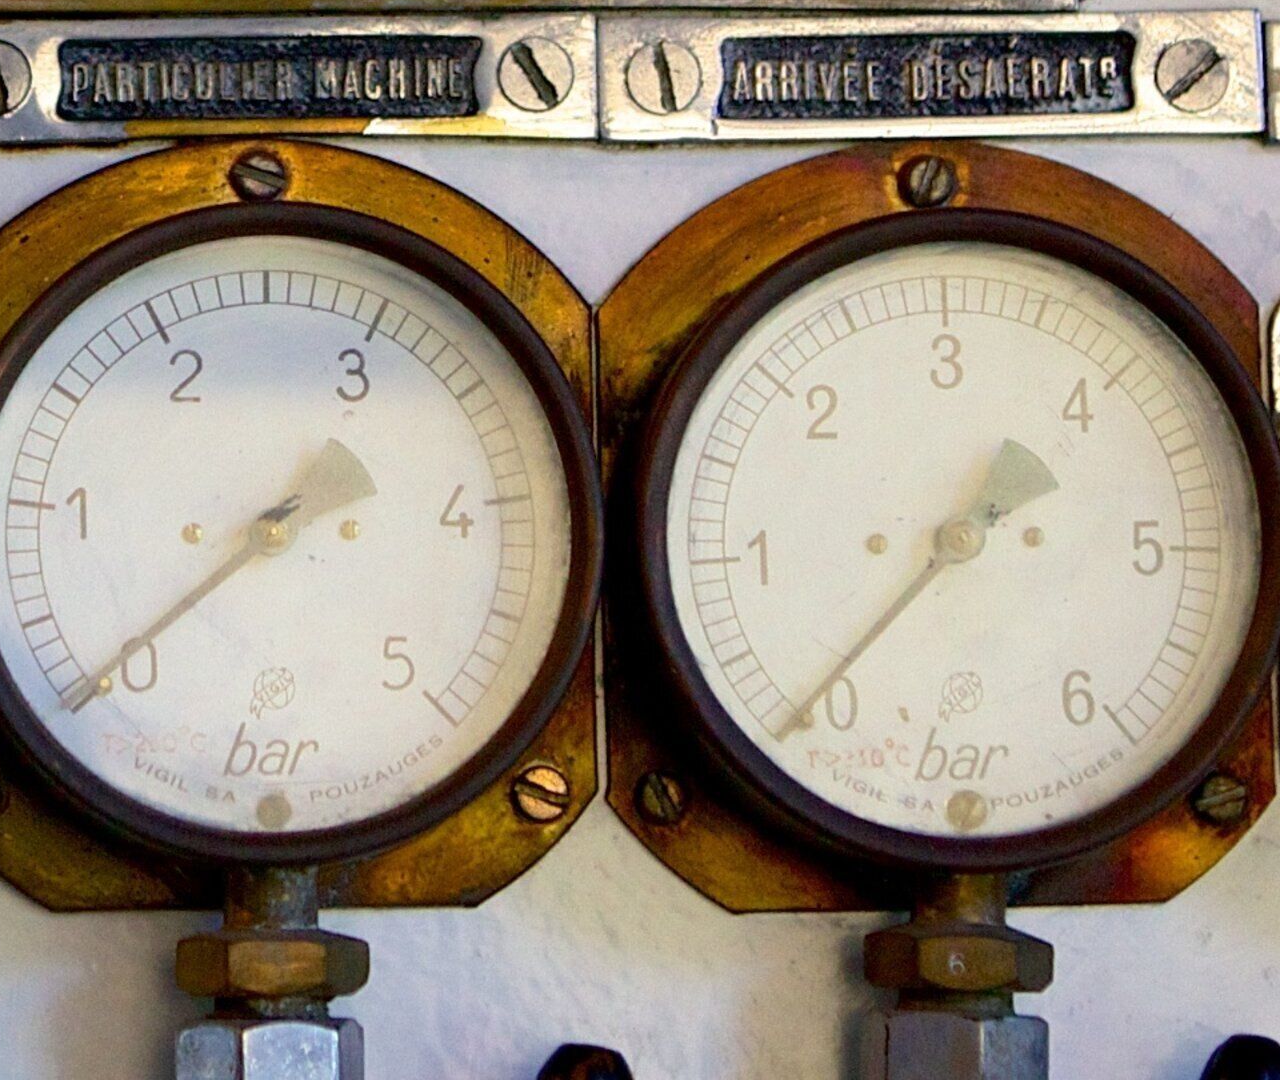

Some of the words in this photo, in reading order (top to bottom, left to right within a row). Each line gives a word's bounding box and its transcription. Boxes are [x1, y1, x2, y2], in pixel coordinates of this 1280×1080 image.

[315, 58, 464, 100] MACHINE
[169, 349, 203, 402] 2
[336, 348, 370, 402] 3
[930, 335, 963, 389] 3
[806, 385, 837, 439] 2
[1062, 378, 1094, 432] 4
[66, 486, 87, 539] 1
[440, 484, 473, 537] 4
[747, 530, 769, 585] 1
[1132, 521, 1164, 576] 5
[121, 637, 158, 692] 0
[383, 636, 415, 690] 5
[824, 676, 858, 731] 0
[1061, 670, 1095, 725] 6
[133, 755, 189, 791] VIGIL
[222, 721, 319, 778] bar
[309, 732, 444, 803] POUZAUGES
[915, 727, 1009, 782] bar
[831, 769, 887, 802] VIGIL
[990, 749, 1124, 810] POUZAUGES
